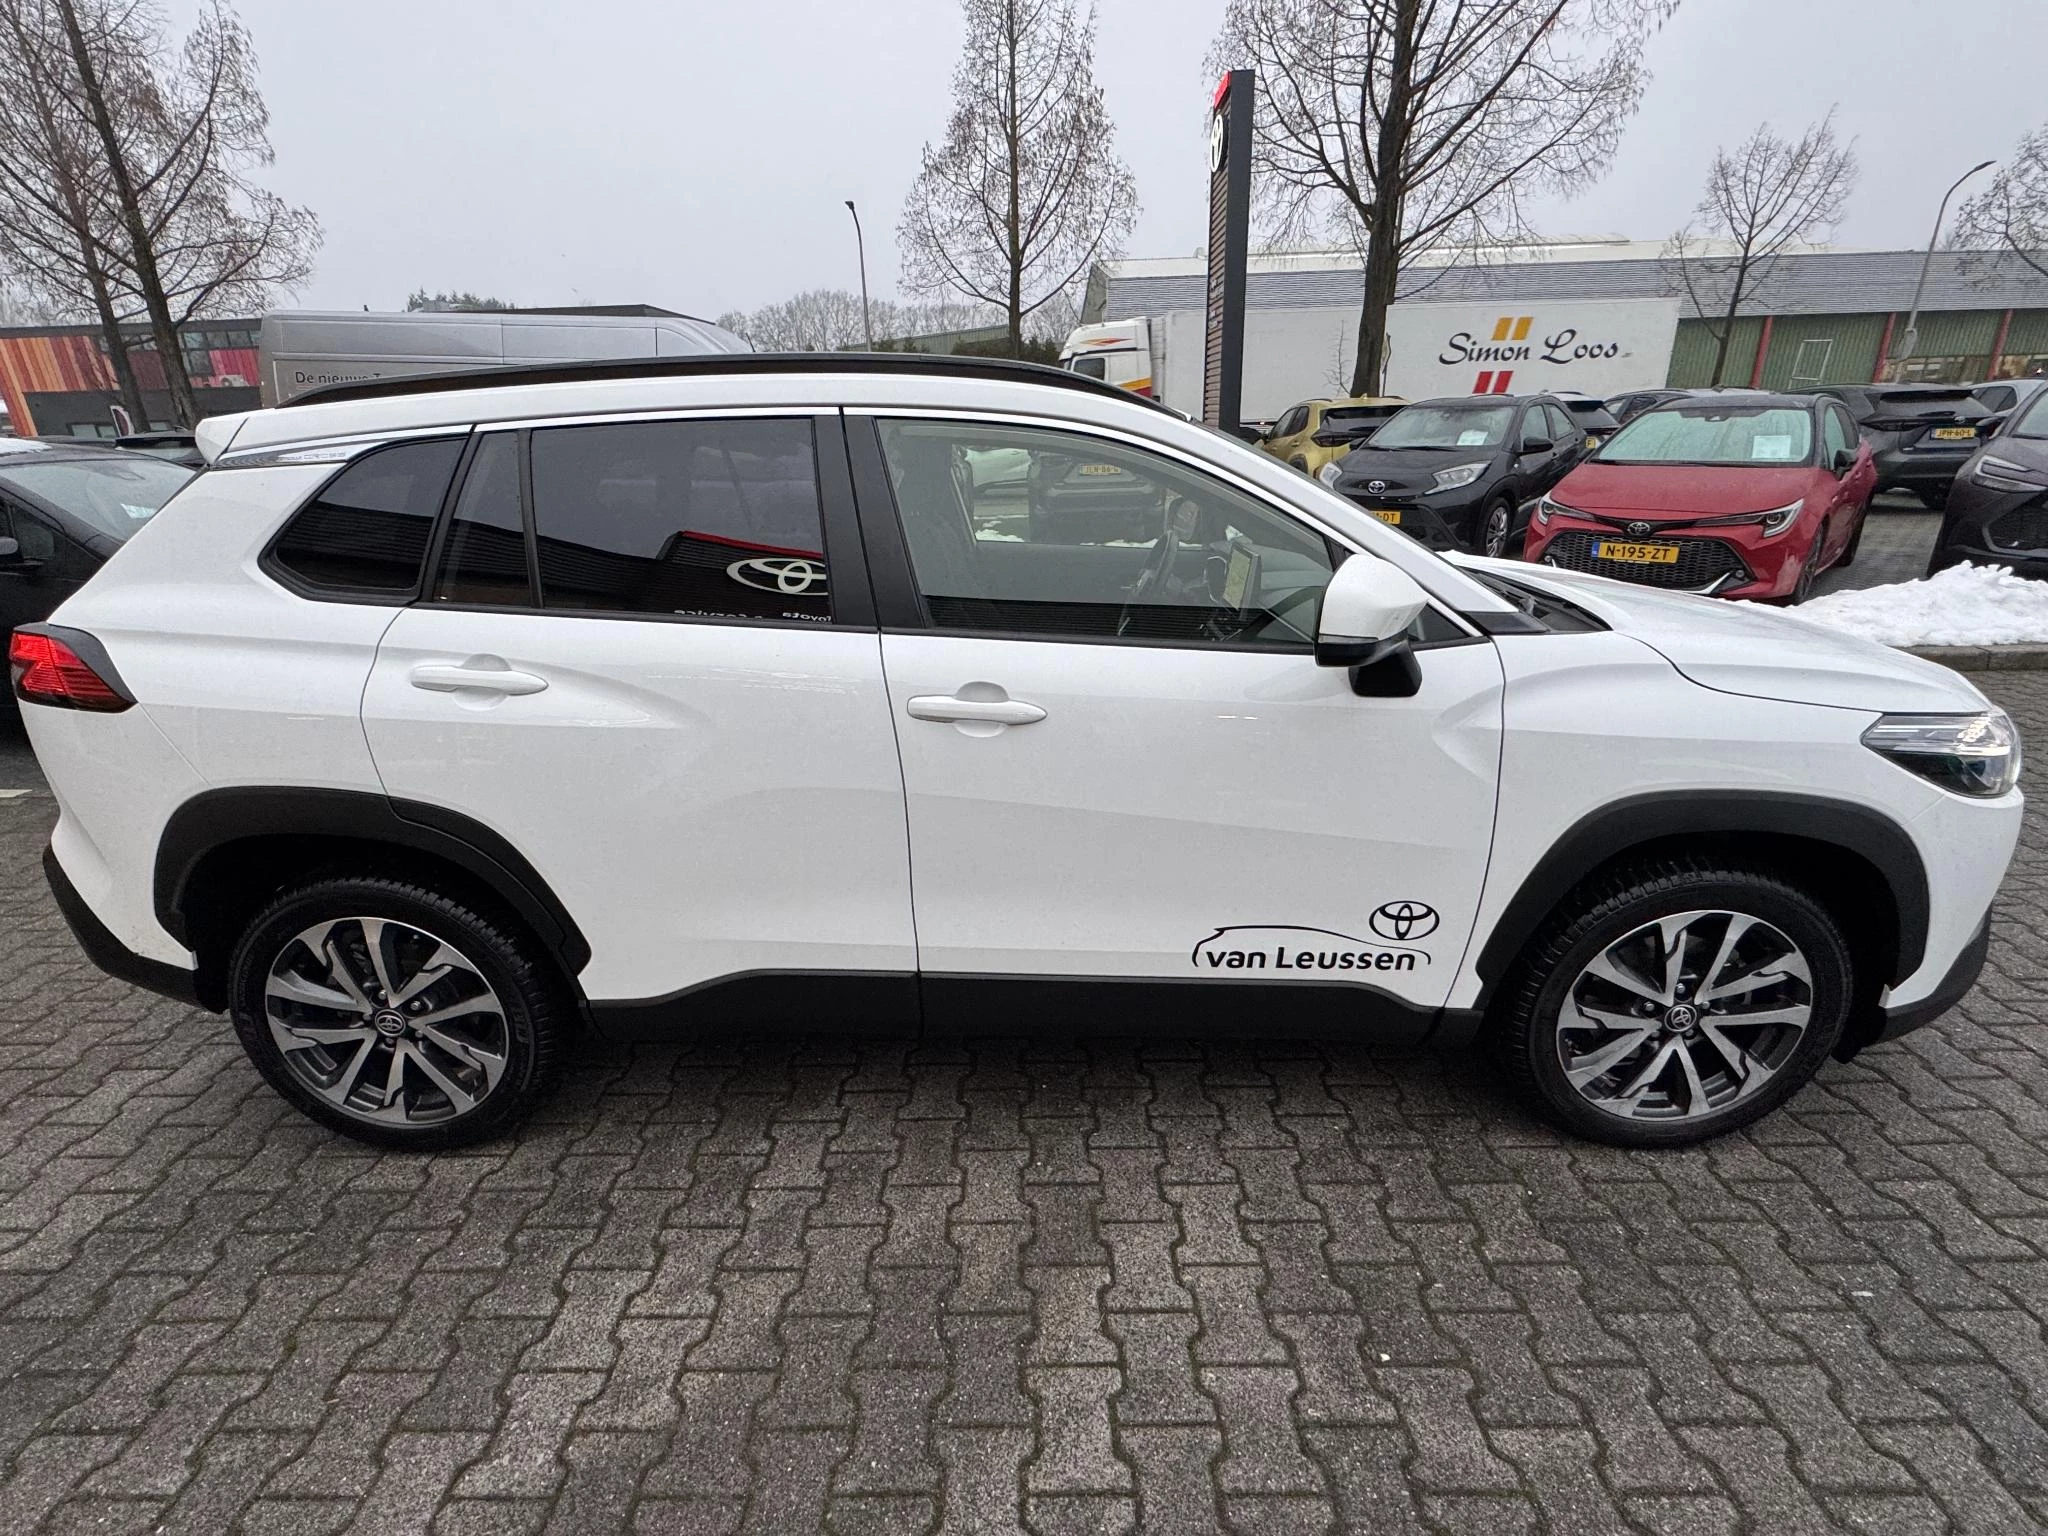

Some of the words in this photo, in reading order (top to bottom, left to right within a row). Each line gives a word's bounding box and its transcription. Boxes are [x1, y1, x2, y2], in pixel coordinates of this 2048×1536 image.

[1438, 331, 1530, 366] Simon
[1539, 328, 1619, 365] Loos
[295, 371, 313, 384] De
[1606, 545, 1671, 561] N-195-ZT
[1206, 950, 1266, 969] van
[1275, 946, 1416, 971] Leussen
